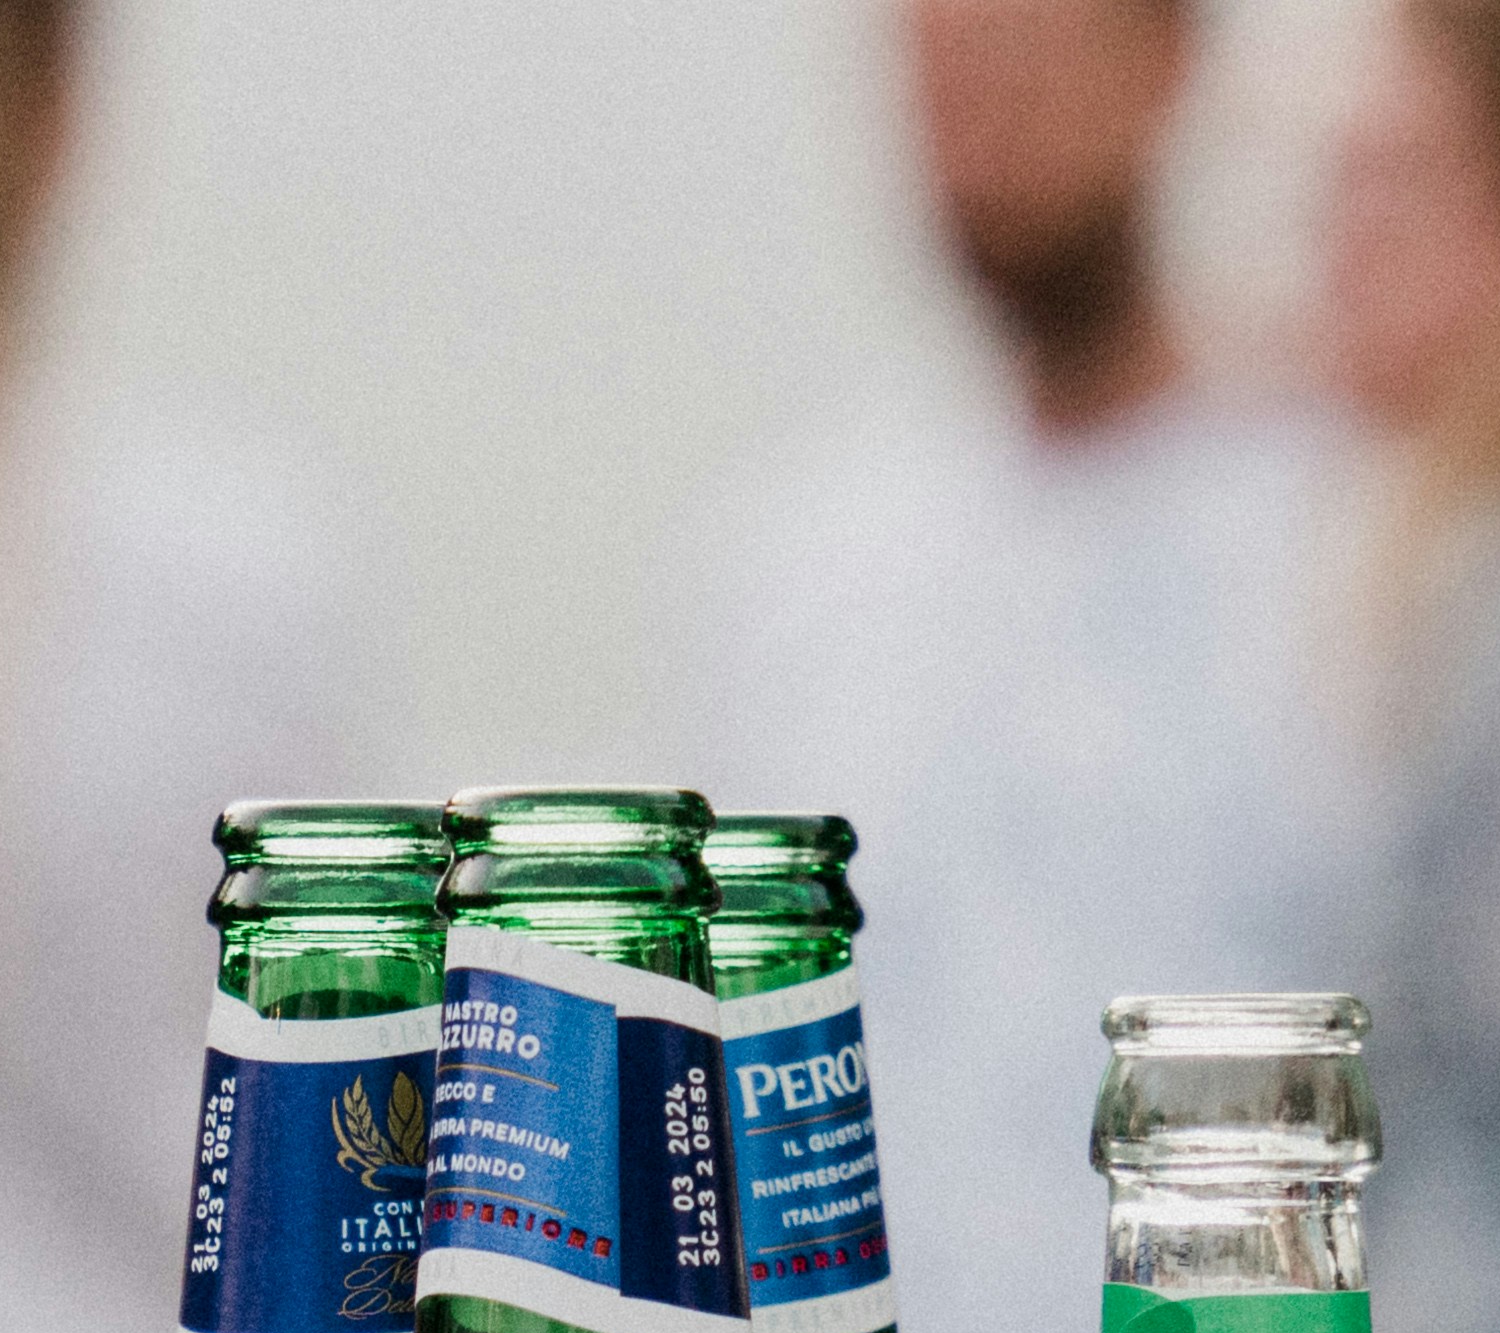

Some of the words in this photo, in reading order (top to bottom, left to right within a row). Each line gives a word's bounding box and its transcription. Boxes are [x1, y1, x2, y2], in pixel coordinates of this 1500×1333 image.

[445, 1001, 518, 1025] NASTRO
[482, 1085, 496, 1104] E
[688, 1067, 711, 1151] 05:50
[201, 1096, 220, 1165] 2024
[214, 1077, 237, 1160] 05:52
[666, 1083, 692, 1156] 2024
[471, 1119, 570, 1159] PREMIUM
[783, 1140, 804, 1158] IL
[808, 1124, 861, 1153] GUSTO
[213, 1167, 228, 1184] 2
[452, 1155, 526, 1181] MONDO
[696, 1159, 714, 1177] 2
[196, 1184, 211, 1219] 03
[374, 1202, 413, 1216] CON
[672, 1175, 695, 1212] 03
[432, 1202, 613, 1259] SUPERIORE
[698, 1190, 721, 1267] 3C23
[191, 1243, 206, 1273] 21
[341, 1240, 416, 1253] ORIGIN
[678, 1235, 701, 1267] 21
[751, 1247, 849, 1283] BIRRA
